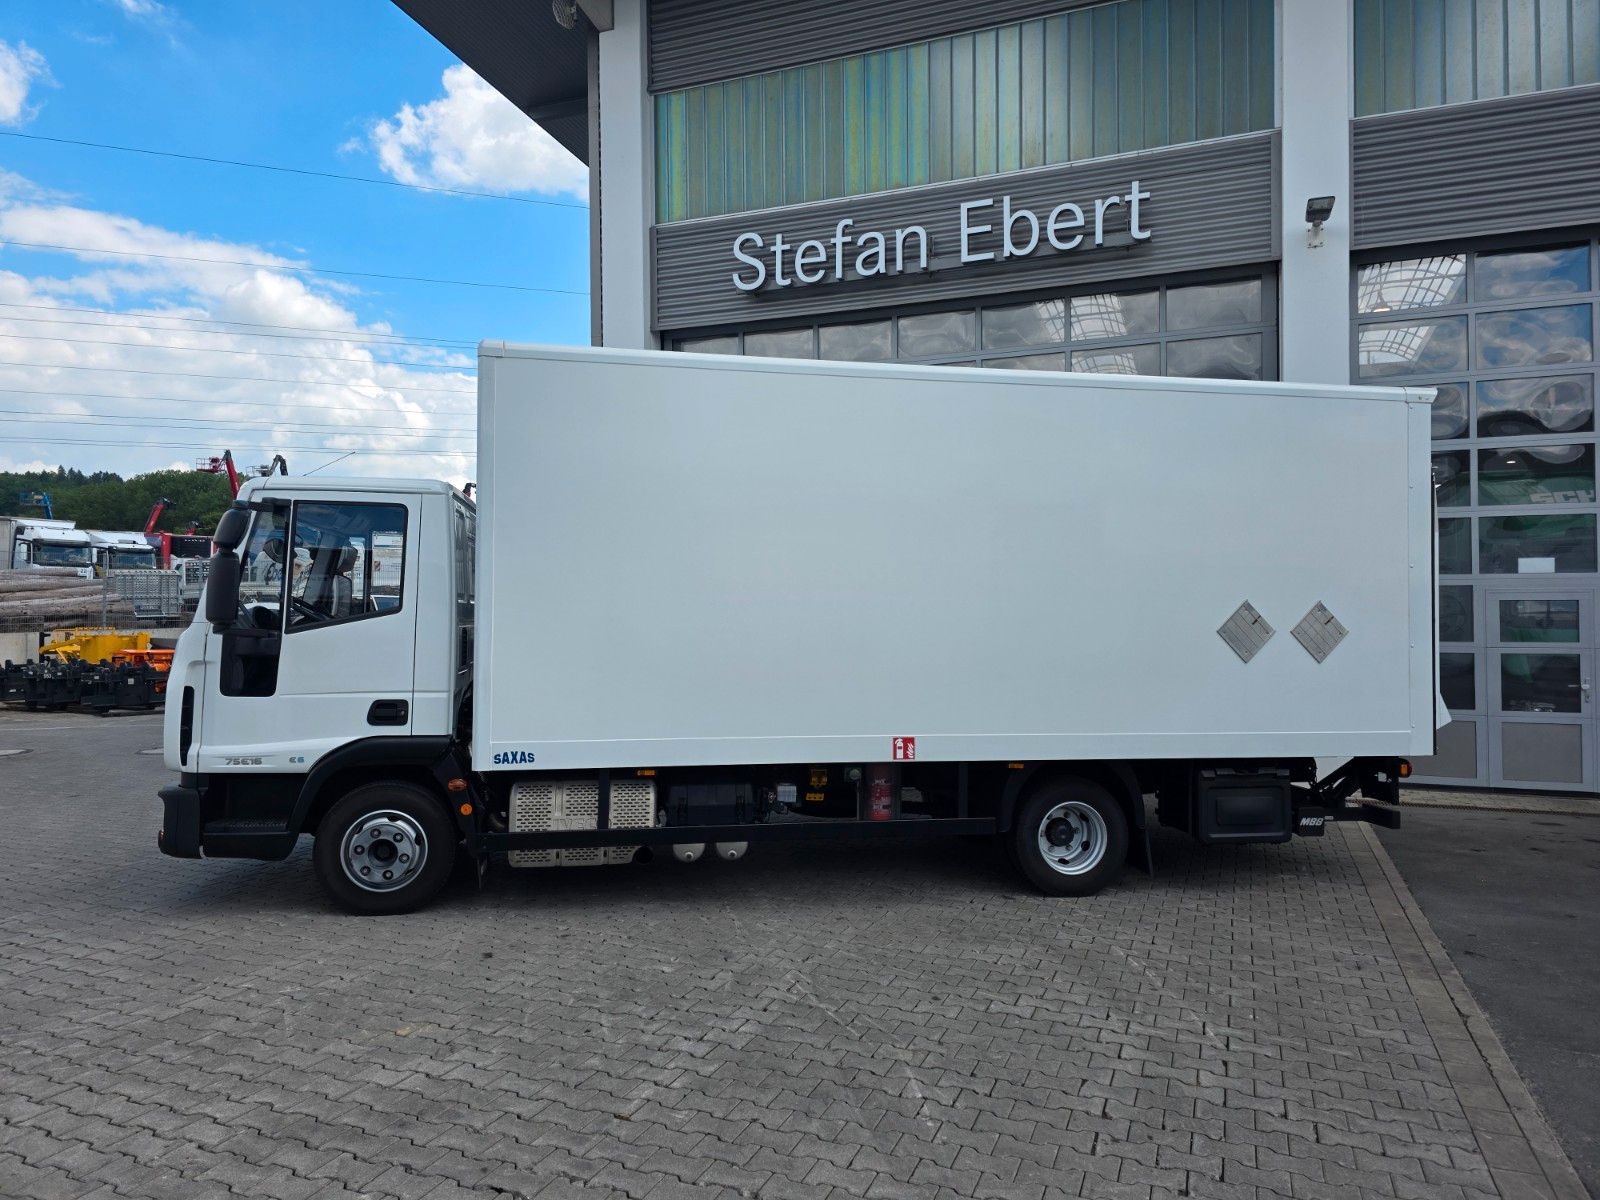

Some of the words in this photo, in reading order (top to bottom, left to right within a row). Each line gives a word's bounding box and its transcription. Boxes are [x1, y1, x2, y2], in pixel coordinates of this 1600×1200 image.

[732, 217, 930, 294] Stefan
[958, 180, 1152, 264] Ebert
[225, 757, 262, 766] 75E16
[493, 751, 535, 765] SAXAS
[1299, 817, 1324, 826] MBB
